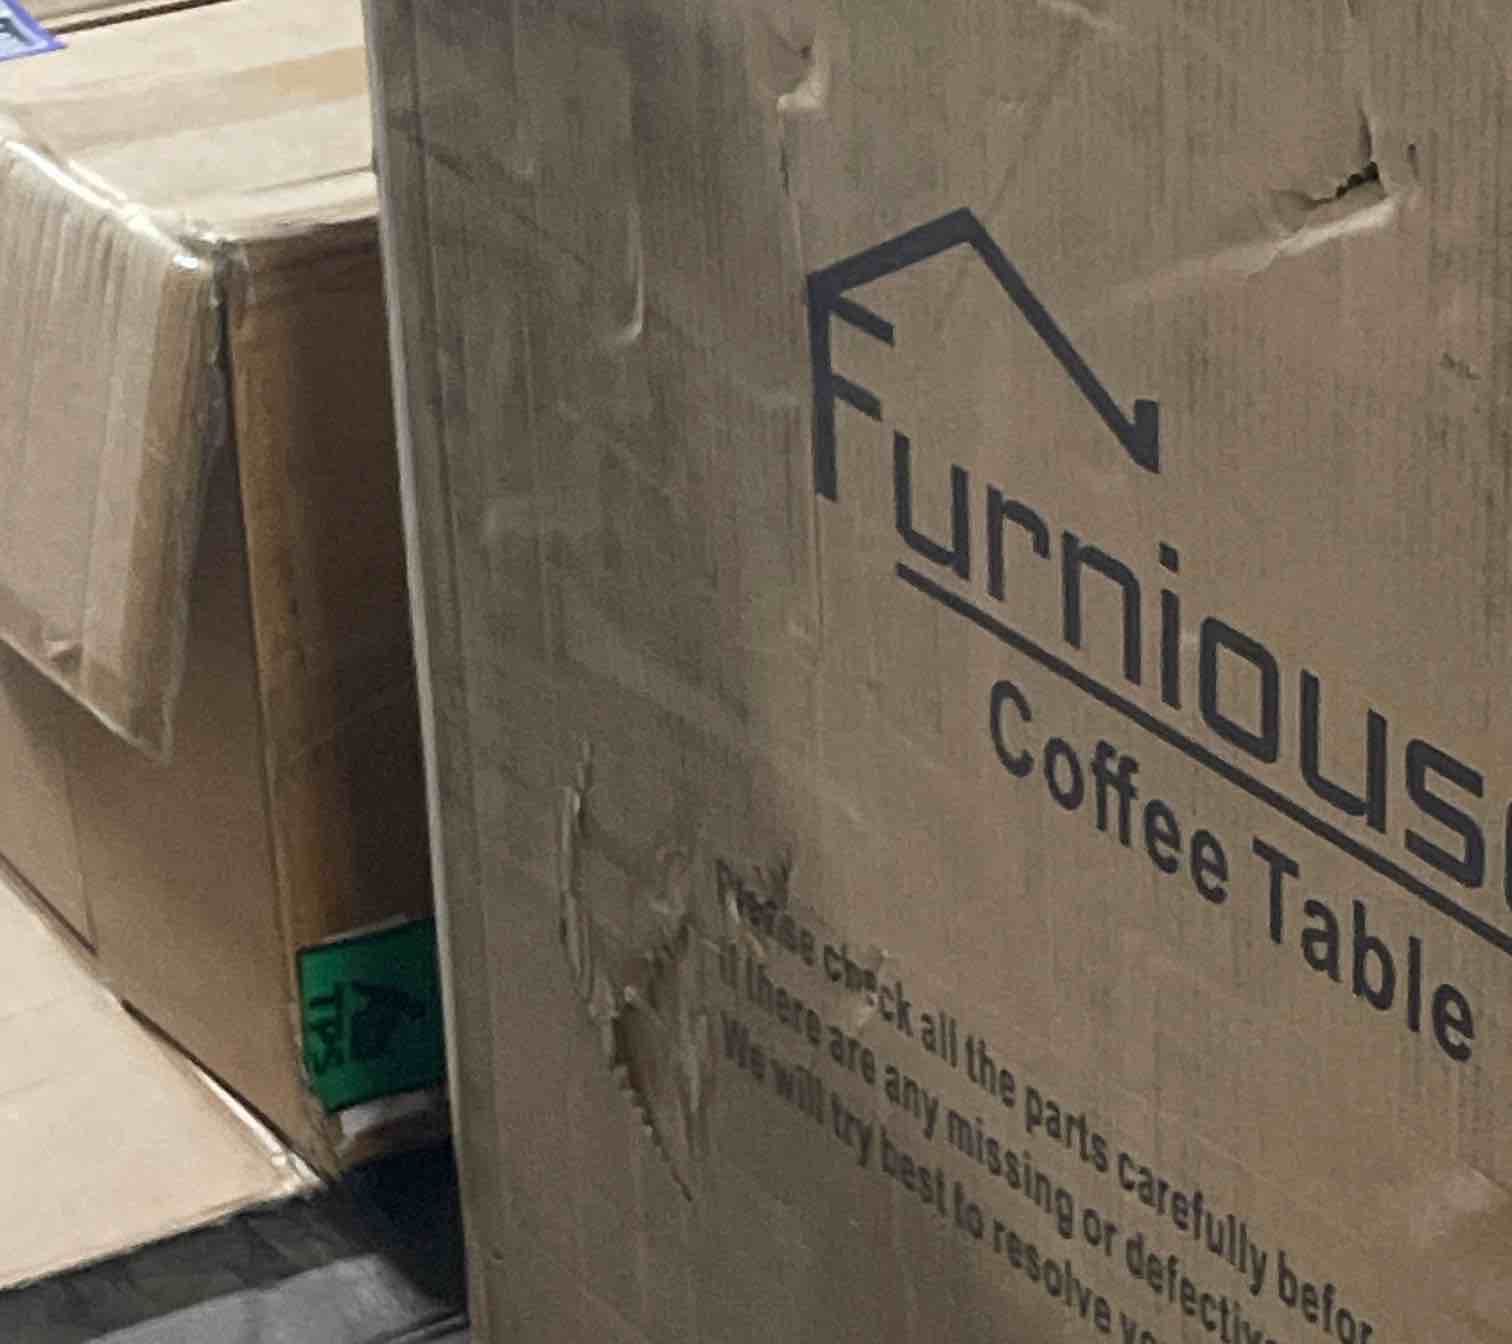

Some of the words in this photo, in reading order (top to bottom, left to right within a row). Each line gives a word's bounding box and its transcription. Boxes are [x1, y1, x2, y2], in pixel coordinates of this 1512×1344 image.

[990, 681, 1230, 904] Coffee
[1252, 836, 1476, 1062] Table
[719, 1010, 765, 1082] We
[769, 1058, 825, 1126] will
[831, 1090, 874, 1168] try
[880, 1123, 946, 1219] best
[954, 1180, 984, 1240] to
[992, 1217, 1112, 1335] resolve
[745, 952, 822, 1046] there
[828, 1024, 876, 1087] are
[884, 1064, 939, 1141] any
[946, 1109, 1074, 1240] missing
[1082, 1207, 1118, 1258] or
[920, 1011, 958, 1070] all
[964, 1034, 1016, 1108] the
[1025, 1086, 1109, 1174] parts
[1117, 1152, 1267, 1297] carefully
